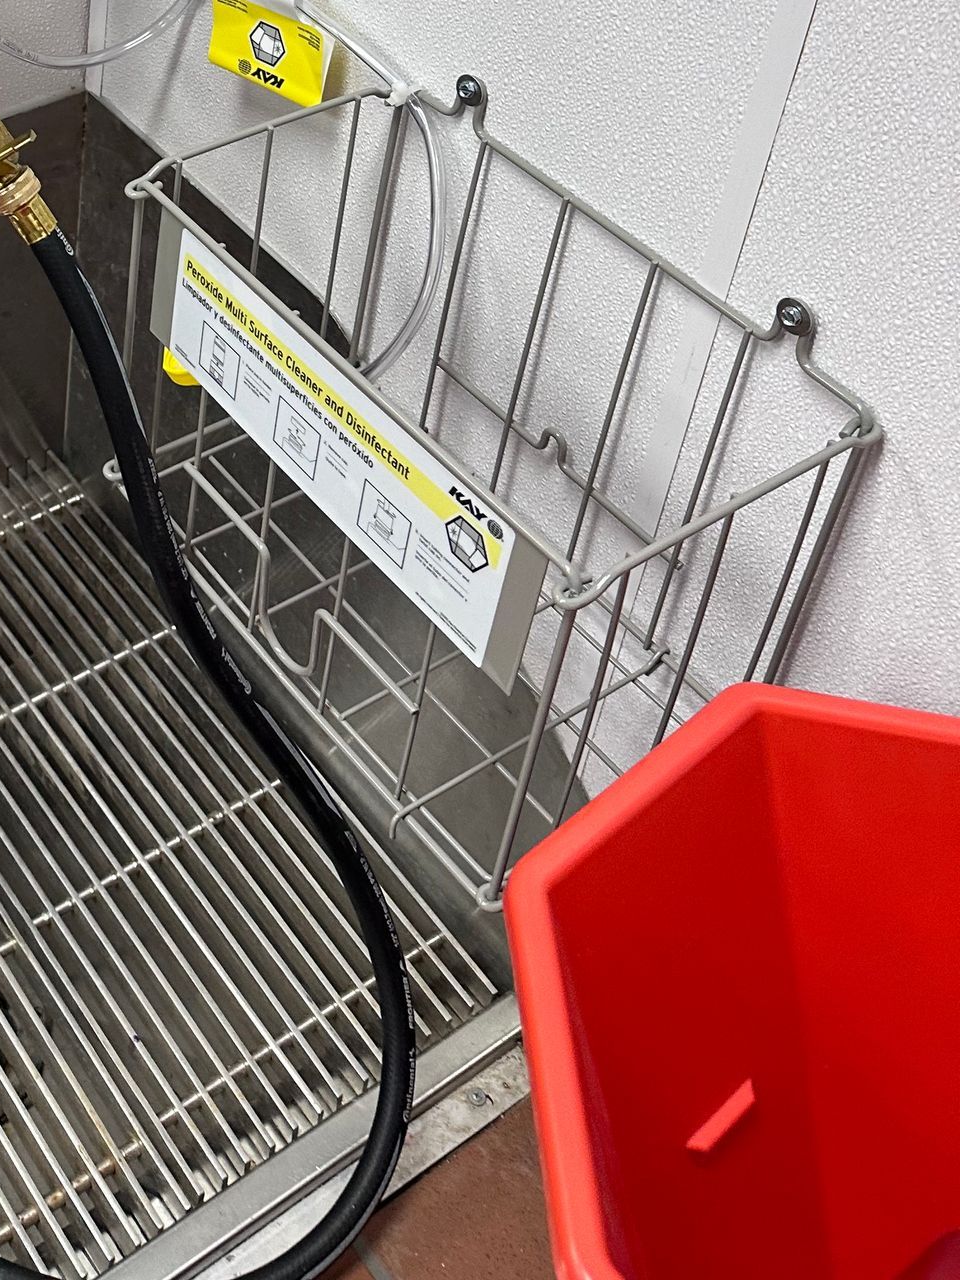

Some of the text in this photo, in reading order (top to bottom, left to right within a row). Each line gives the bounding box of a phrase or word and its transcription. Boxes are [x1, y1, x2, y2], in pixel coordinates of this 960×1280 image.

[251, 67, 285, 89] KAY
[182, 278, 213, 311] Limpiador
[213, 310, 219, 320] y
[219, 313, 265, 363] desinfectante
[265, 360, 322, 419] multisuperficies
[323, 417, 338, 434] con
[338, 431, 374, 469] peróxido
[187, 260, 224, 303] Peroxide
[225, 296, 248, 326] Multi
[249, 320, 284, 360] Surface
[286, 356, 323, 396] Cleaner
[324, 395, 344, 417] and
[346, 412, 410, 480] Disinfectant
[448, 486, 488, 521] KAY
